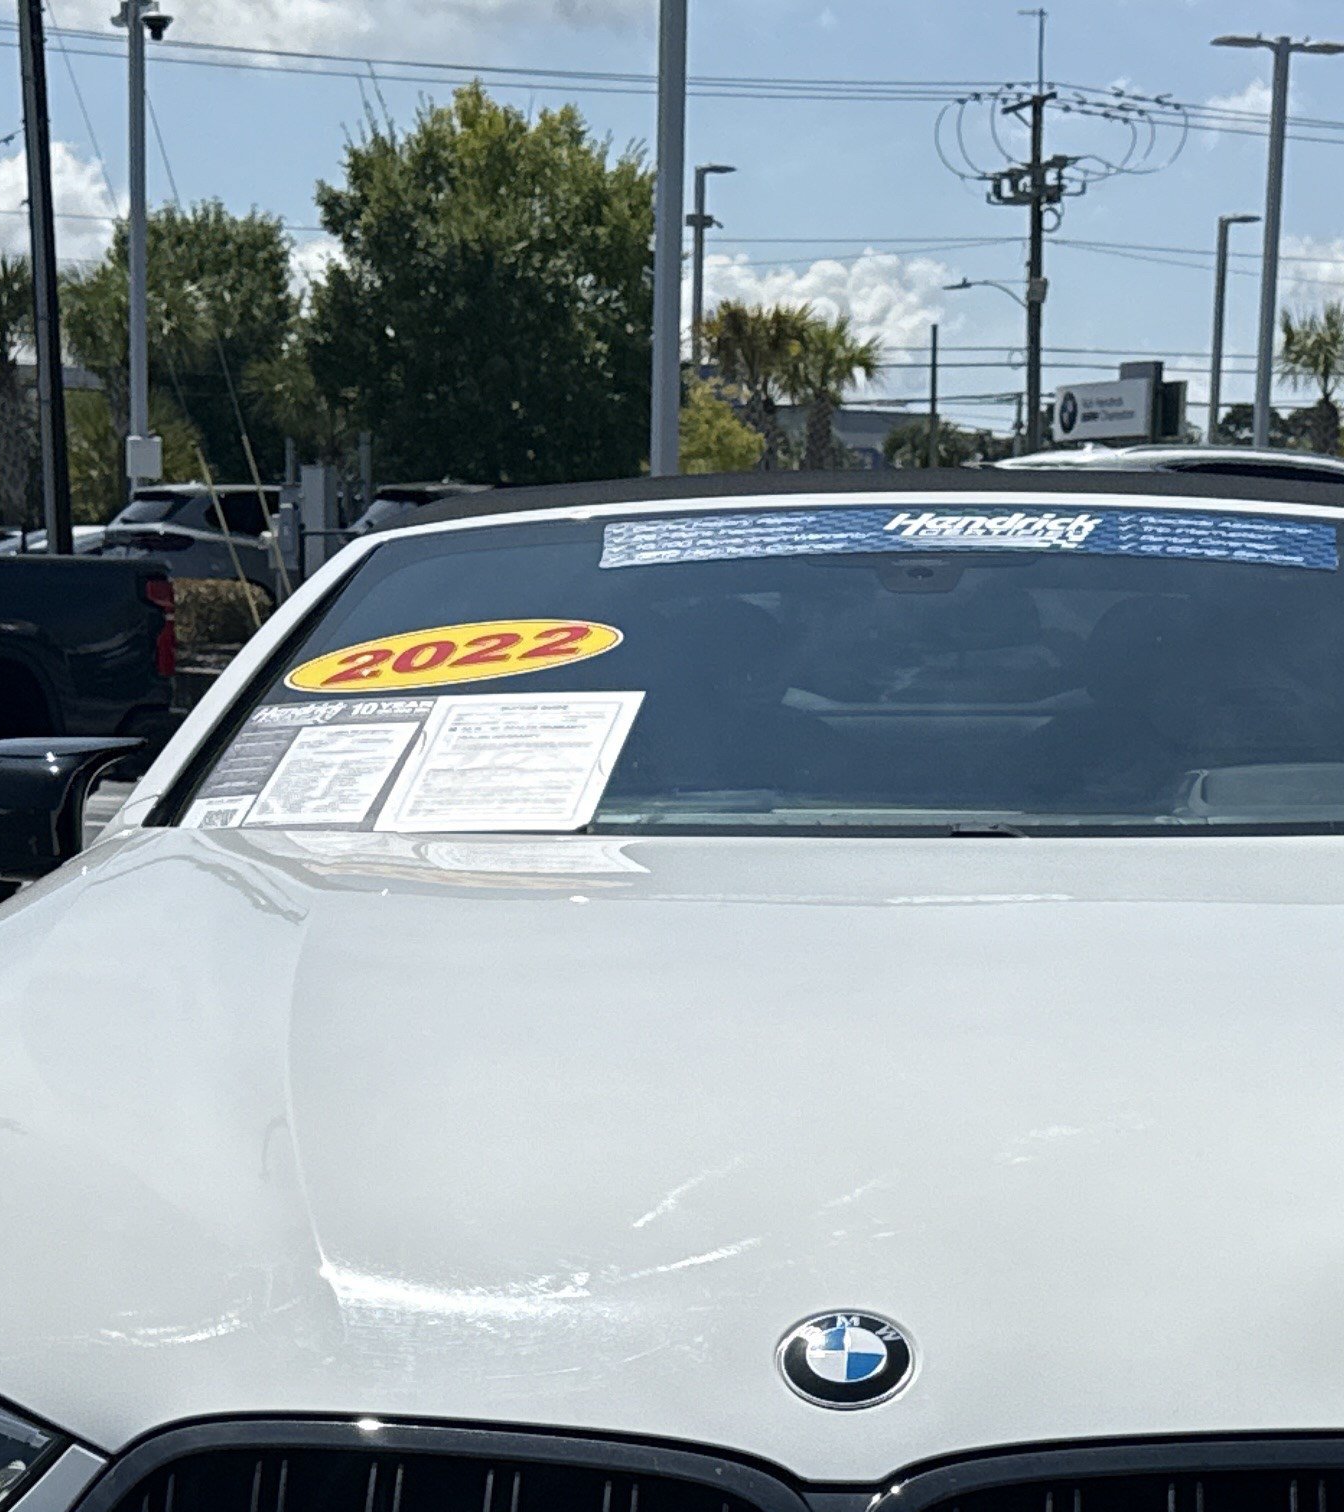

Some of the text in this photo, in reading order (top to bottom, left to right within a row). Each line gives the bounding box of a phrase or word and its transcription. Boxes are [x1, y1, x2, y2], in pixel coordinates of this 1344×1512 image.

[883, 512, 1103, 542] Hendrick
[320, 624, 592, 687] 2022
[351, 702, 379, 716] 10
